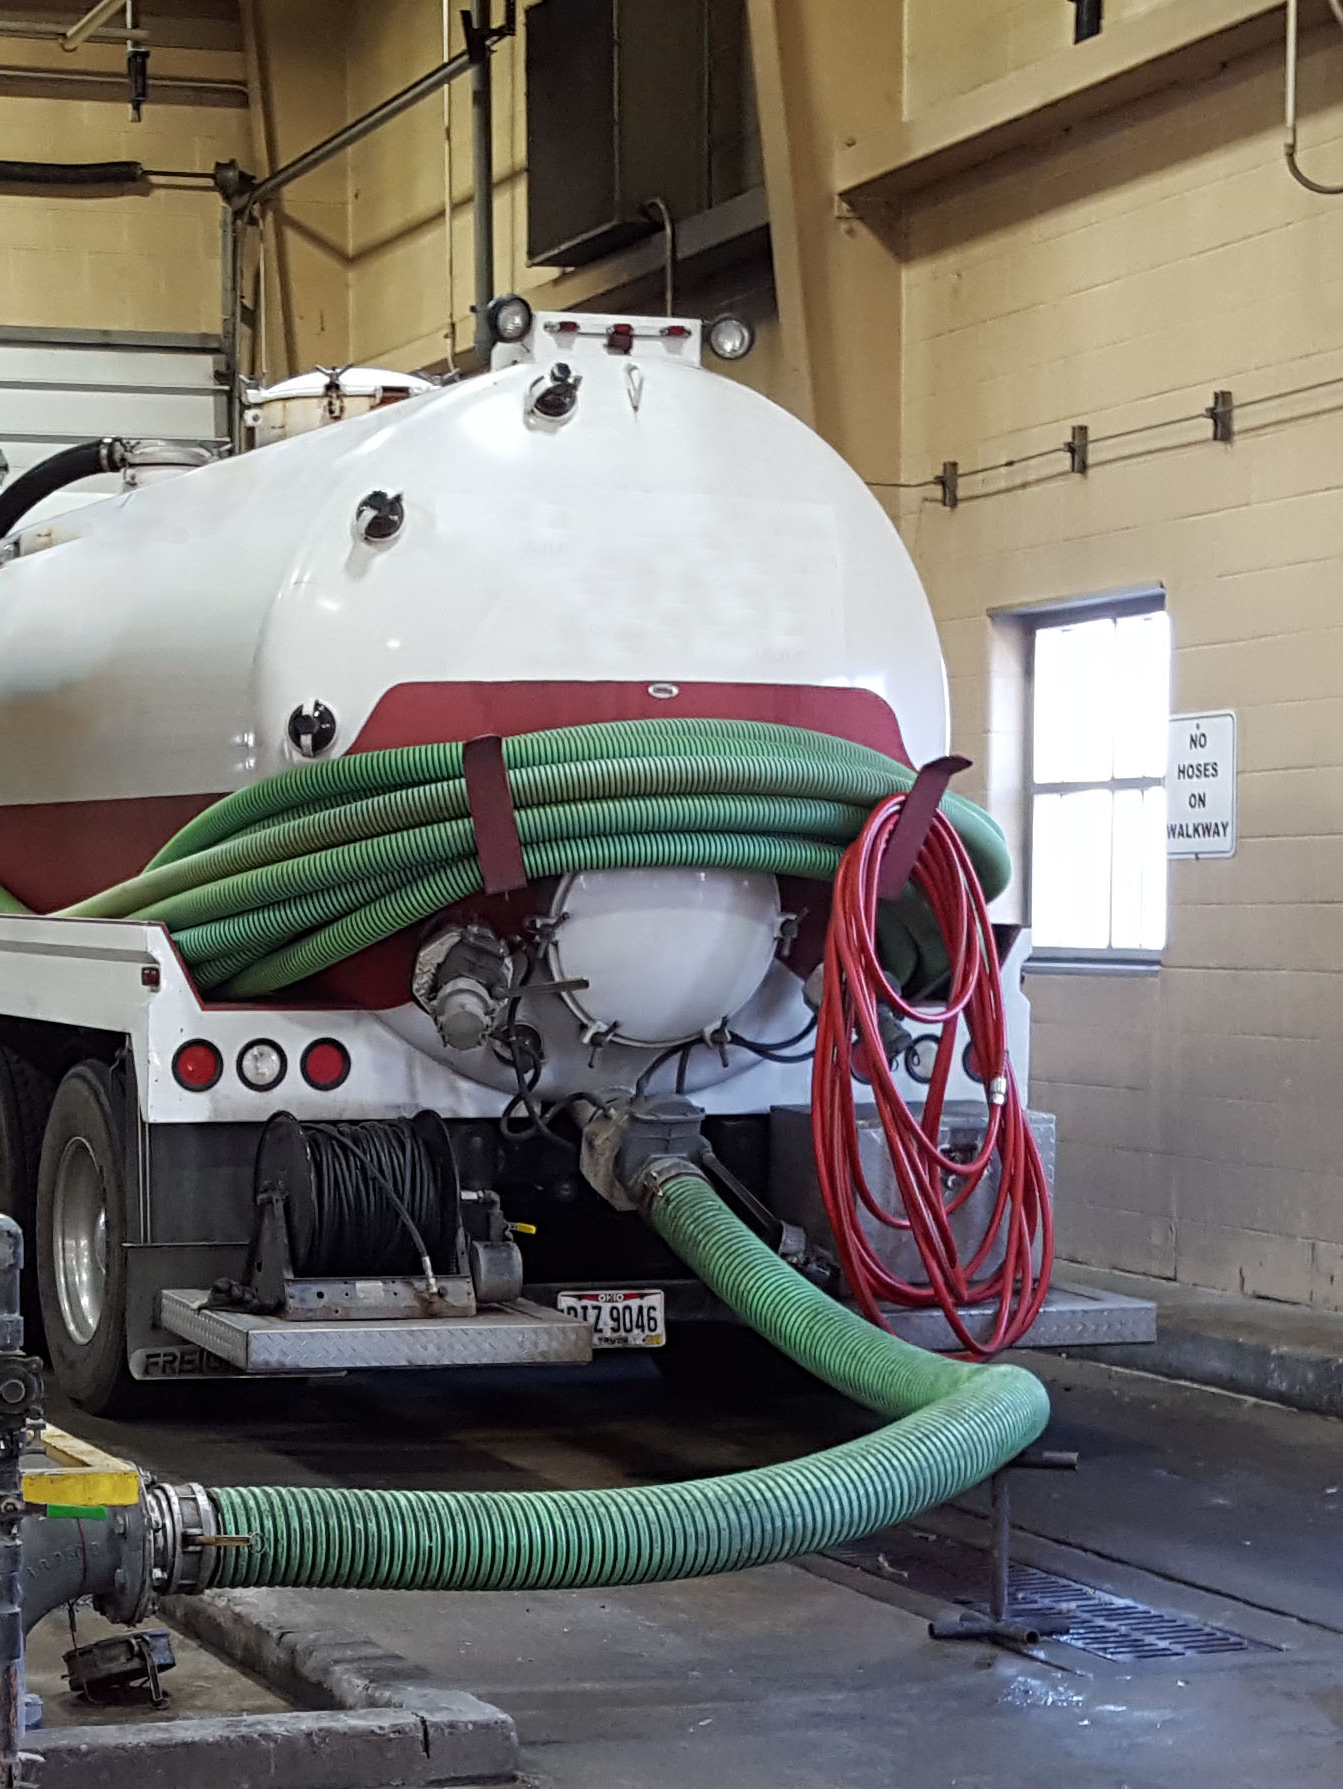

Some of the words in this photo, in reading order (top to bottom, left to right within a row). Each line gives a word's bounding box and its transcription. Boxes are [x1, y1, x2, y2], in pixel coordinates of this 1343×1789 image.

[1189, 732, 1207, 749] NO
[1177, 762, 1218, 780] HOSES
[1188, 792, 1206, 809] ON
[1167, 821, 1229, 839] WALKWAY
[609, 1304, 658, 1334] 9046
